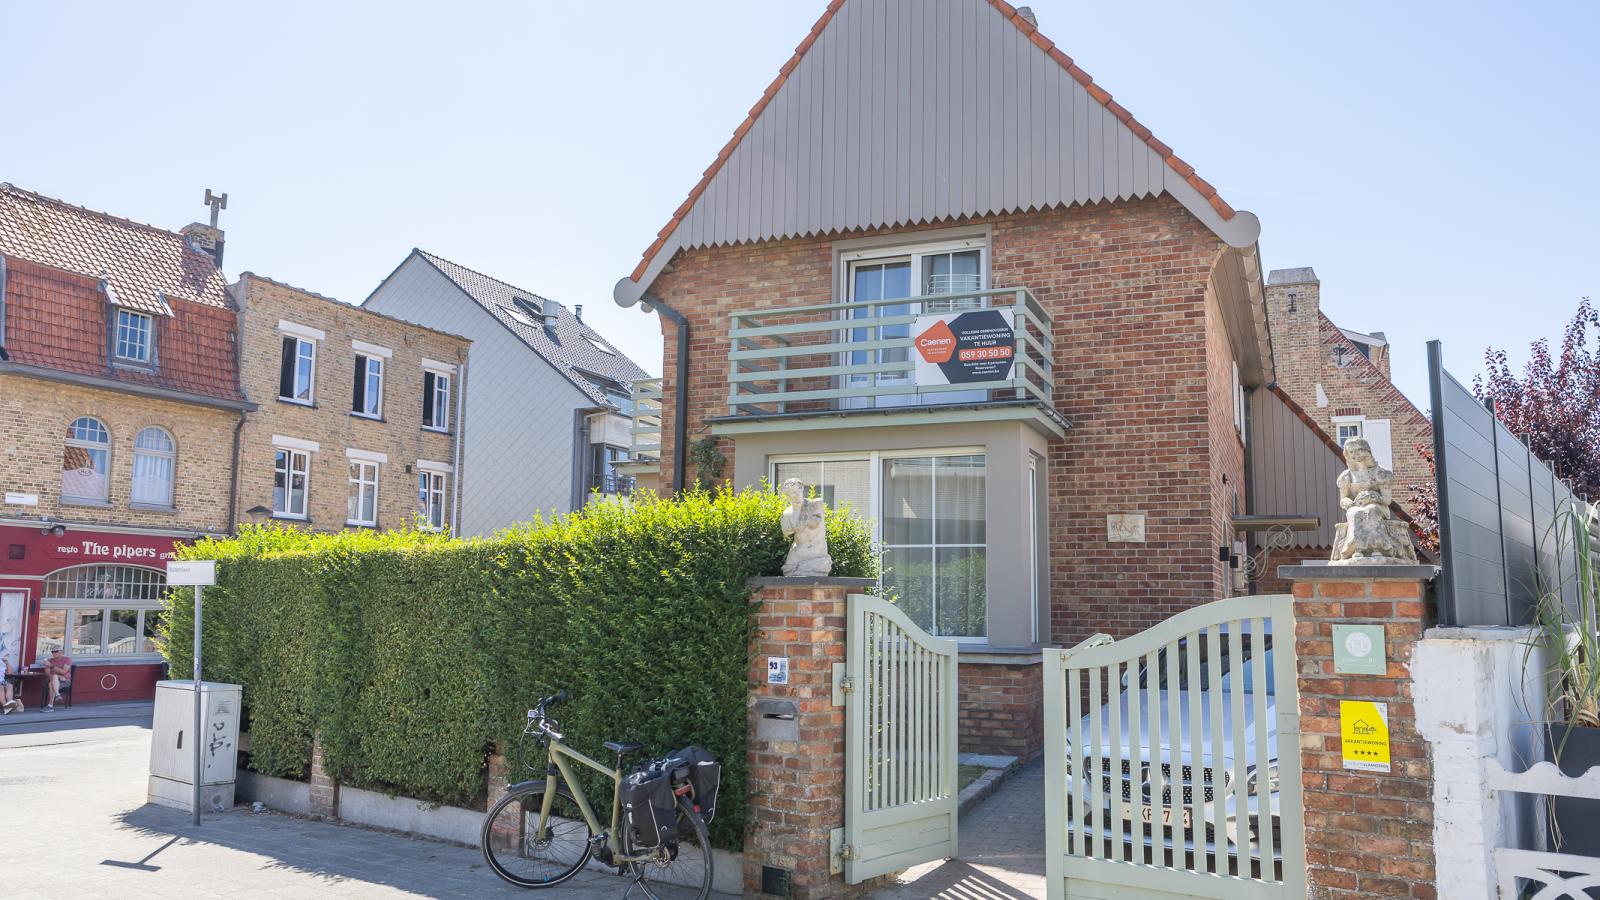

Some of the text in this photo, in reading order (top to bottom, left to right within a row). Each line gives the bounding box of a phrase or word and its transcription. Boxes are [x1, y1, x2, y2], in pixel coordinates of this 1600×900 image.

[960, 333, 1011, 341] VAKANTIEWONING
[920, 338, 951, 347] Caenen
[978, 350, 986, 358] 30
[988, 349, 998, 357] 50
[58, 546, 78, 554] resto
[82, 541, 110, 556] The
[113, 544, 156, 558] pipers
[770, 662, 778, 670] 93
